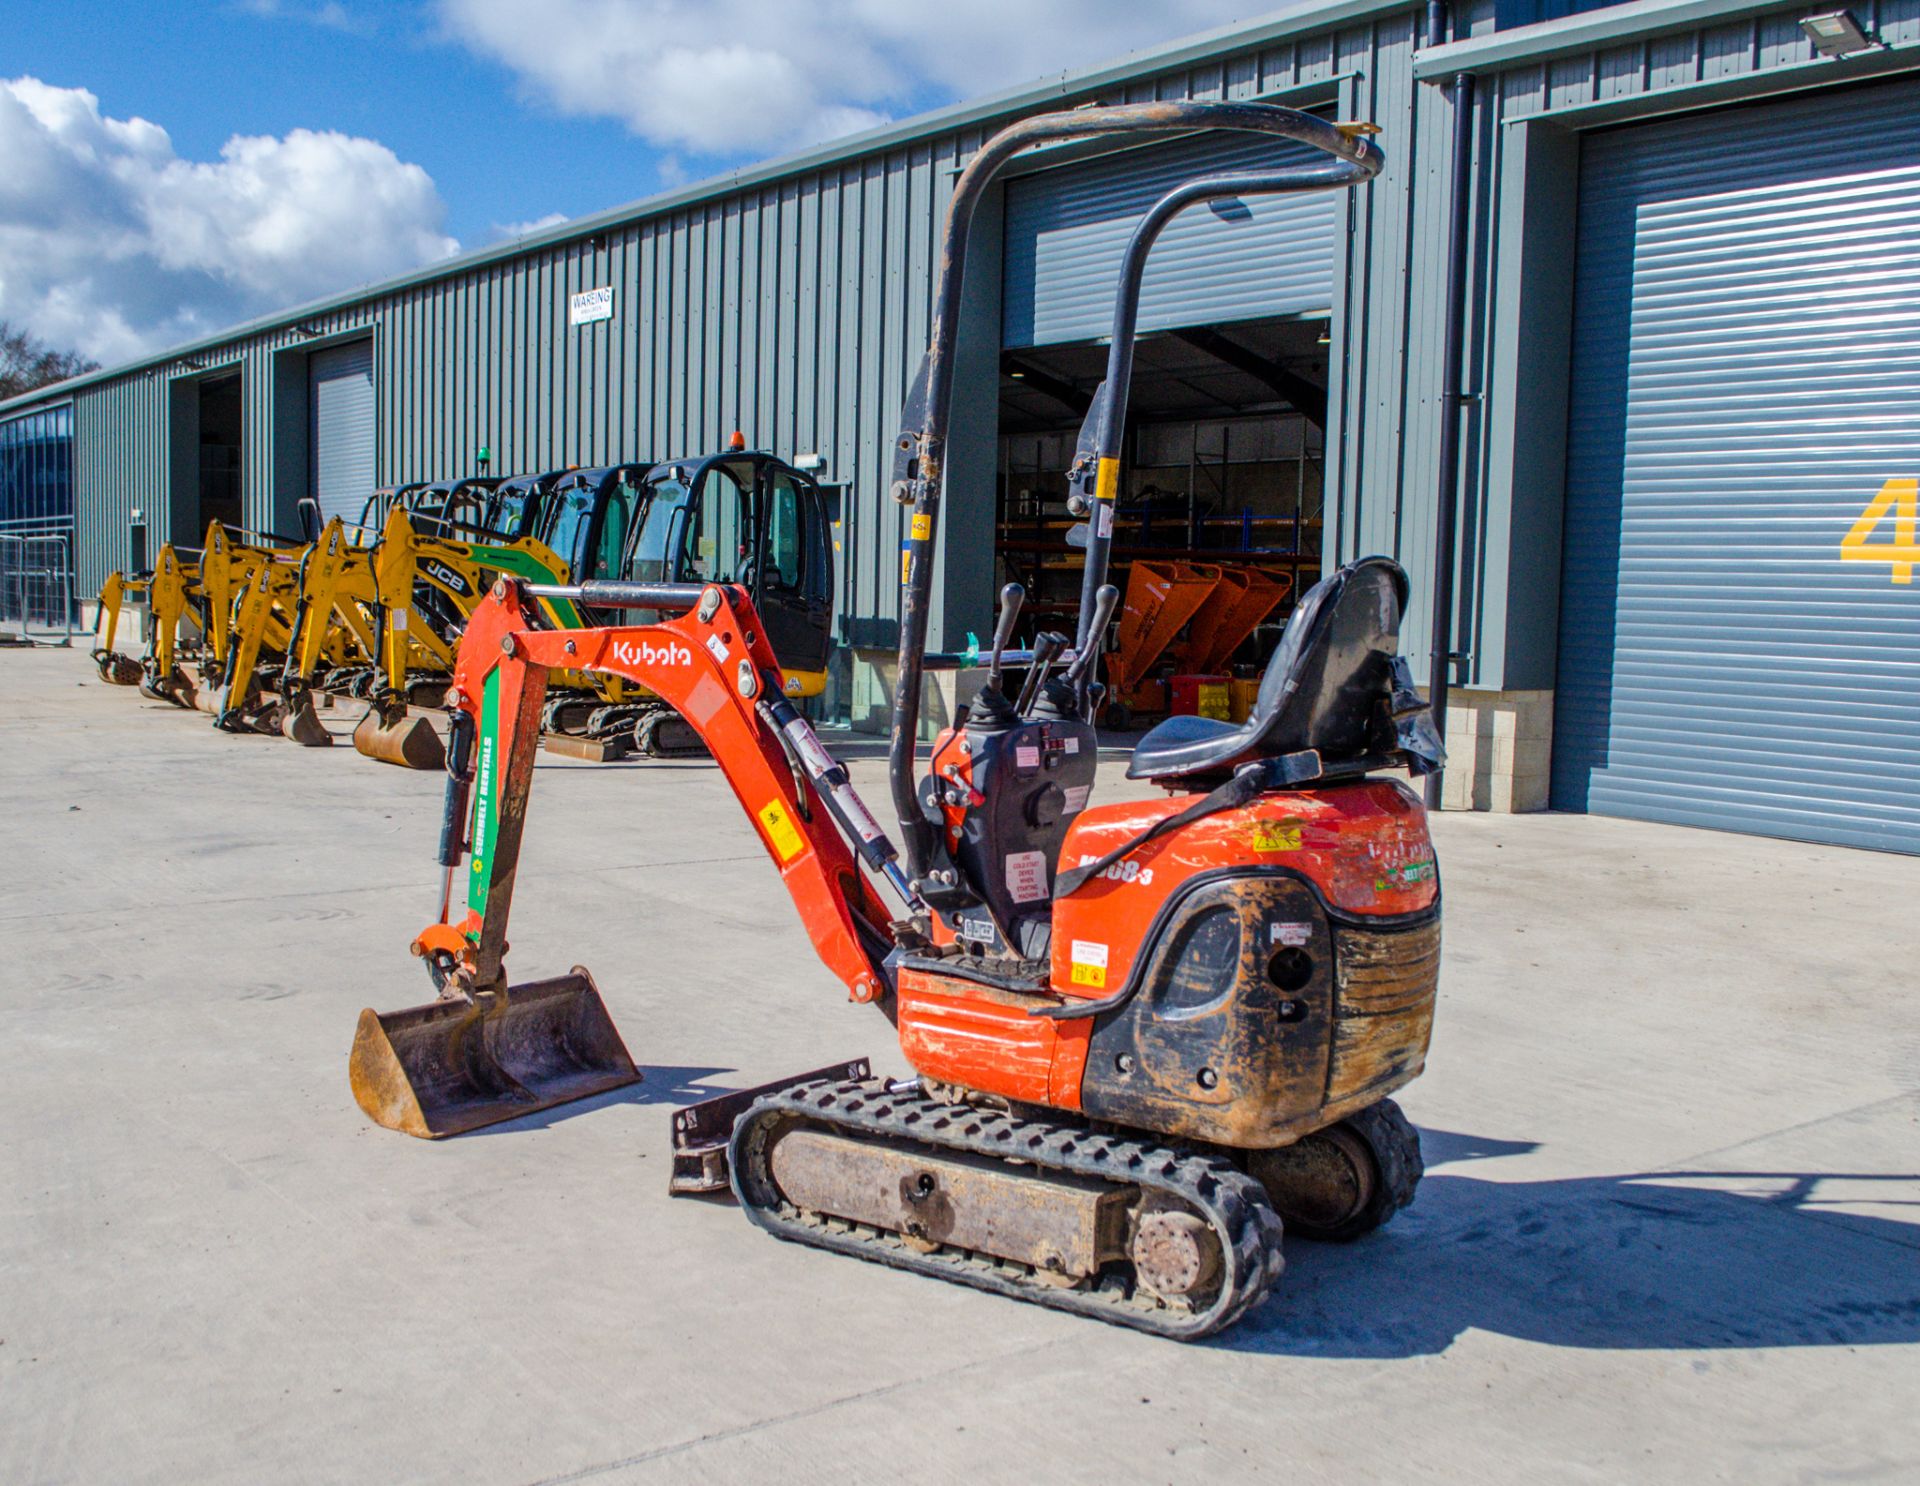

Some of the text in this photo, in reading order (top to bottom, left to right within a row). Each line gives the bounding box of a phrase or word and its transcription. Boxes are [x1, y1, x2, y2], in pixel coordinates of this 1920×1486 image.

[573, 287, 610, 308] WAREING
[1841, 478, 1920, 584] 4
[426, 562, 465, 592] JCB
[613, 641, 692, 666] Kubota
[474, 736, 492, 857] SUNBELT RENTALS
